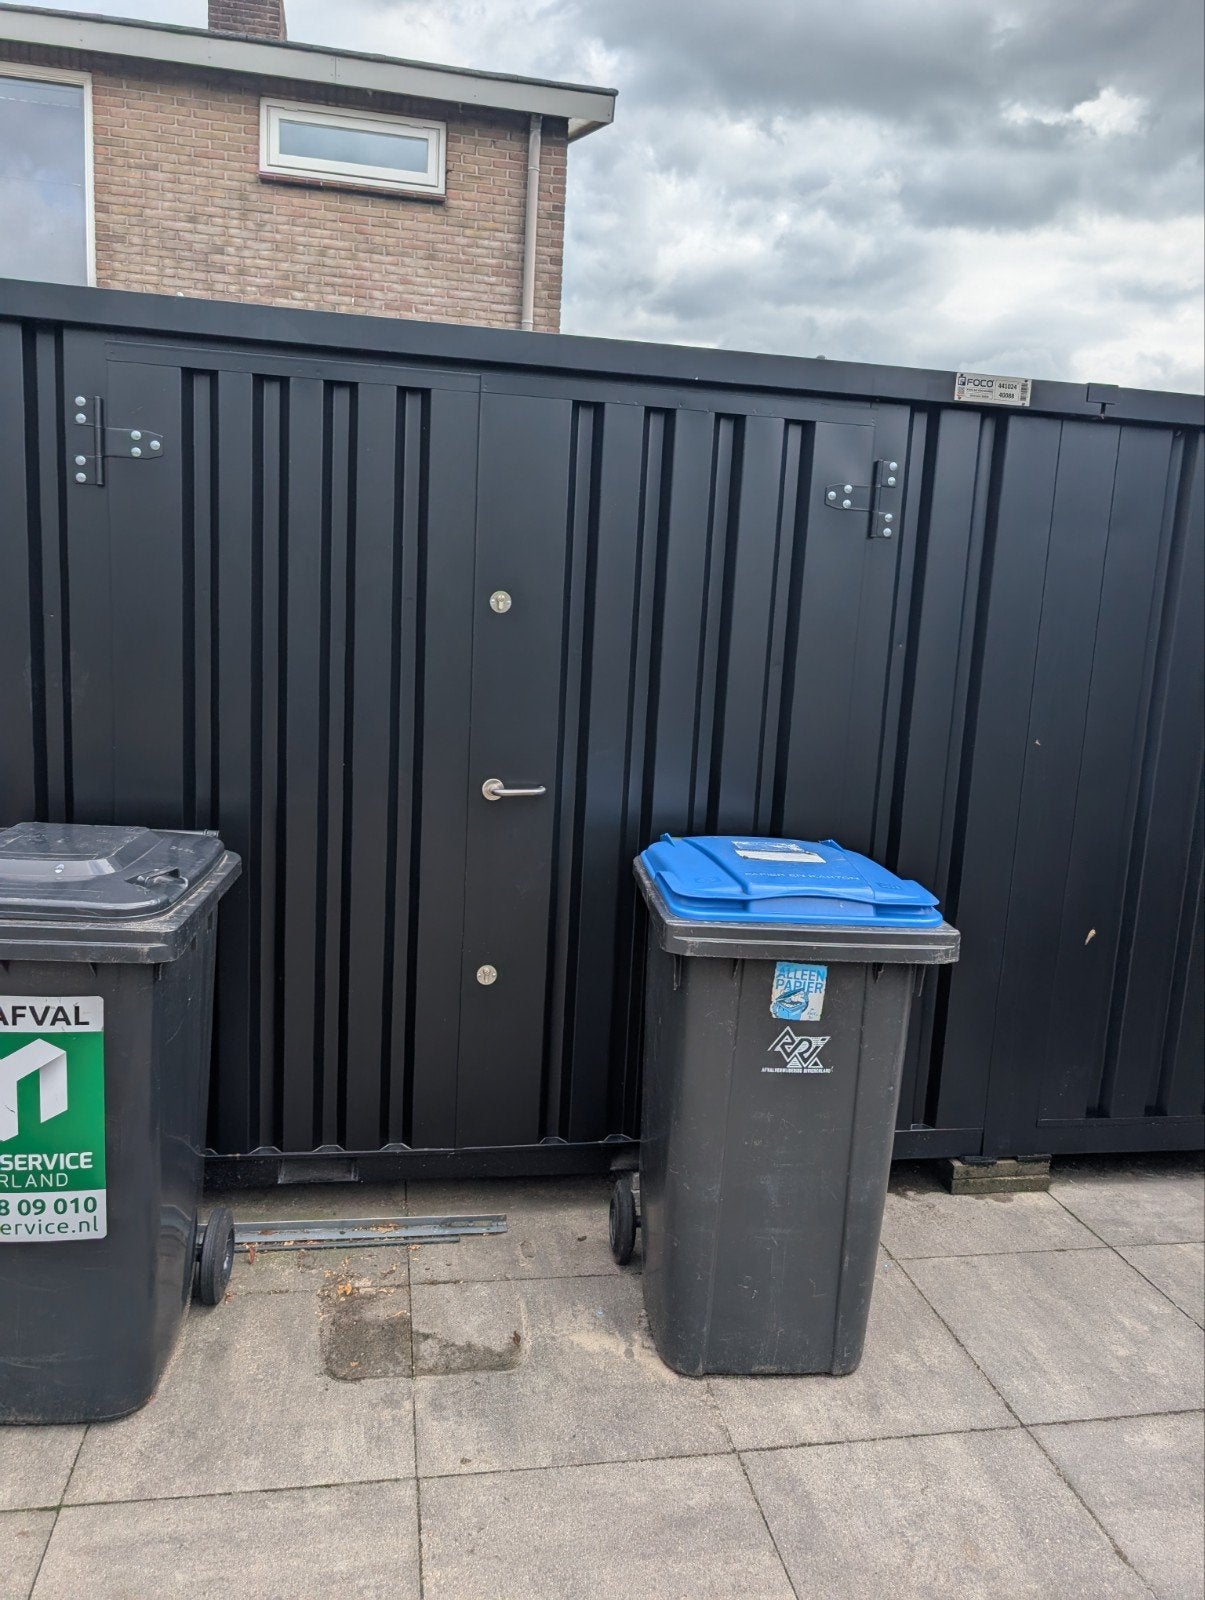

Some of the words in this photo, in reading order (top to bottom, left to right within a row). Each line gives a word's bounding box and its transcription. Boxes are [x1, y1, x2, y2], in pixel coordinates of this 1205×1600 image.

[967, 378, 994, 388] FOCO
[776, 967, 826, 982] ALLEEN
[775, 979, 824, 994] PAPIER
[0, 1151, 94, 1171] SERVICE
[17, 1198, 46, 1216] 09
[53, 1196, 97, 1214] 010
[0, 1215, 99, 1236] ervice.nl
